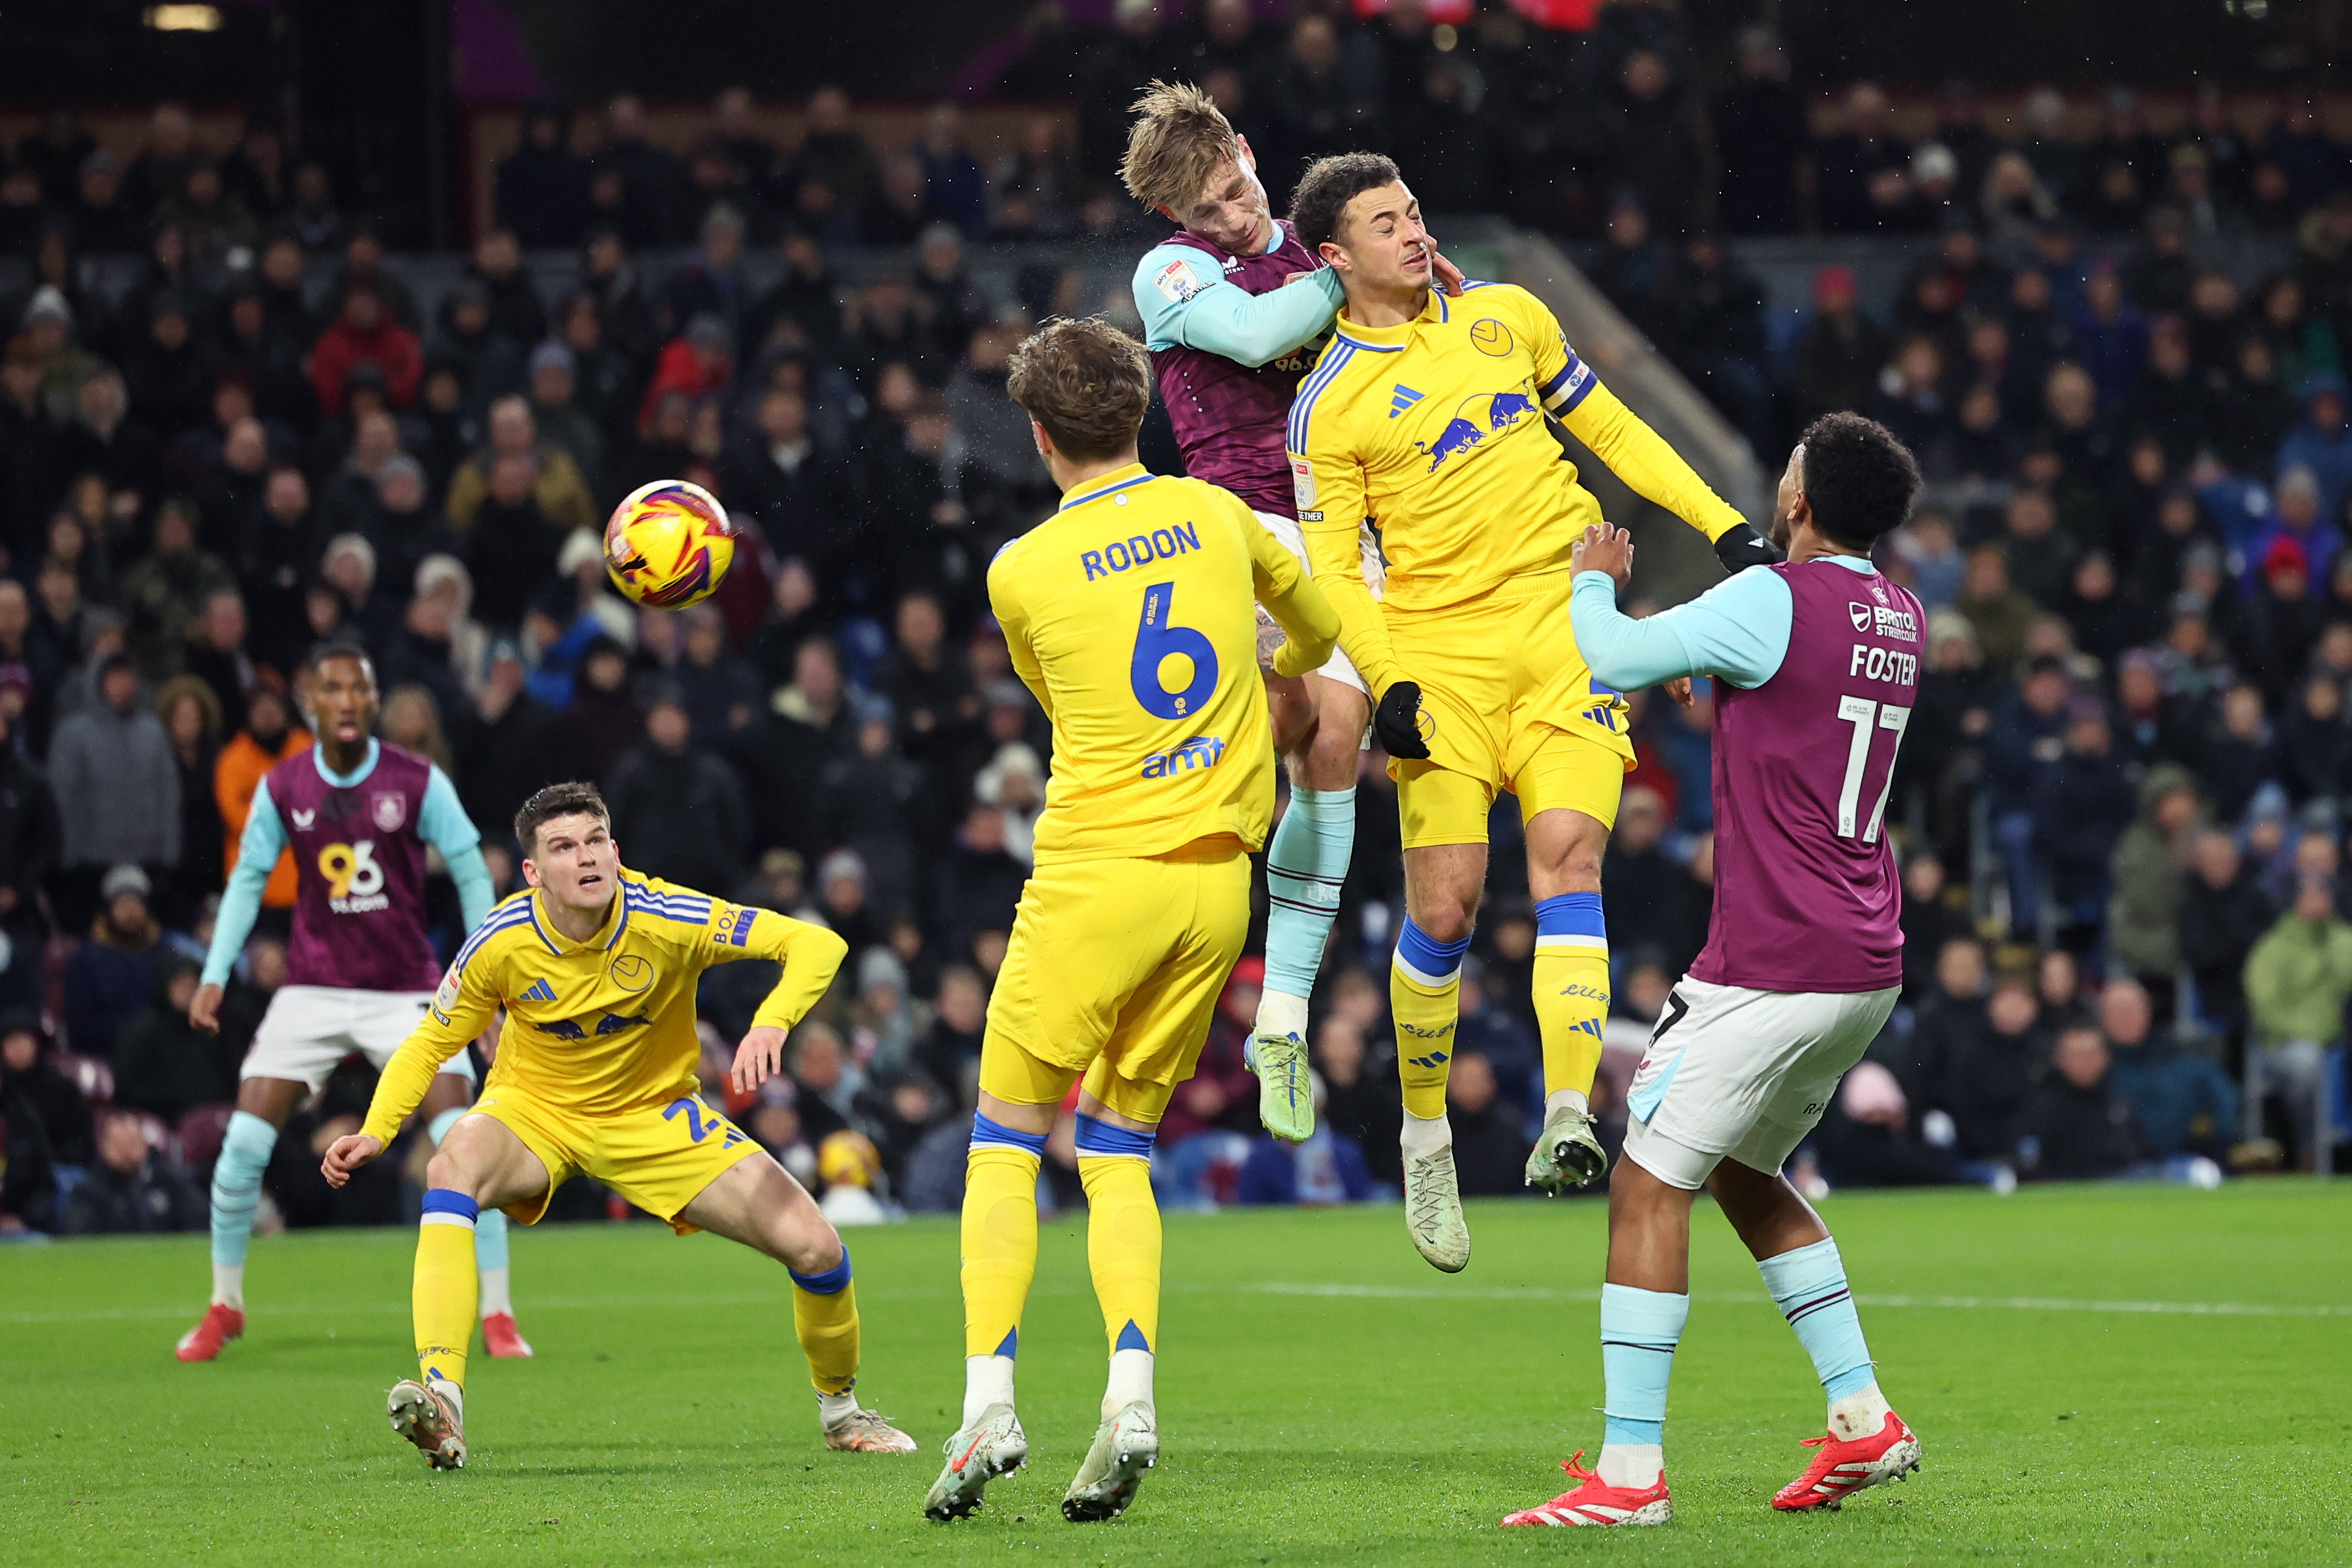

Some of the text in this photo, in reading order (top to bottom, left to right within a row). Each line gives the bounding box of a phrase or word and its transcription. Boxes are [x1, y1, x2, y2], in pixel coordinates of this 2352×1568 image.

[1157, 273, 1167, 285] sky
[1224, 266, 1245, 275] STORE
[1180, 287, 1191, 296] EFL
[1183, 281, 1214, 302] GETHER
[1275, 354, 1318, 372] 96.C
[1298, 510, 1322, 521] GETHER
[1080, 521, 1201, 581] RODON
[1874, 606, 1917, 631] BRSTOL
[1131, 581, 1218, 720] 6
[1850, 644, 1916, 686] FOSTER
[1141, 736, 1225, 779] amt
[1837, 694, 1911, 843] 17
[318, 840, 385, 897] 96
[714, 907, 738, 944] BOX
[733, 909, 757, 938] LIFE
[432, 1004, 449, 1026] ETHER
[1399, 1016, 1458, 1038] LUF
